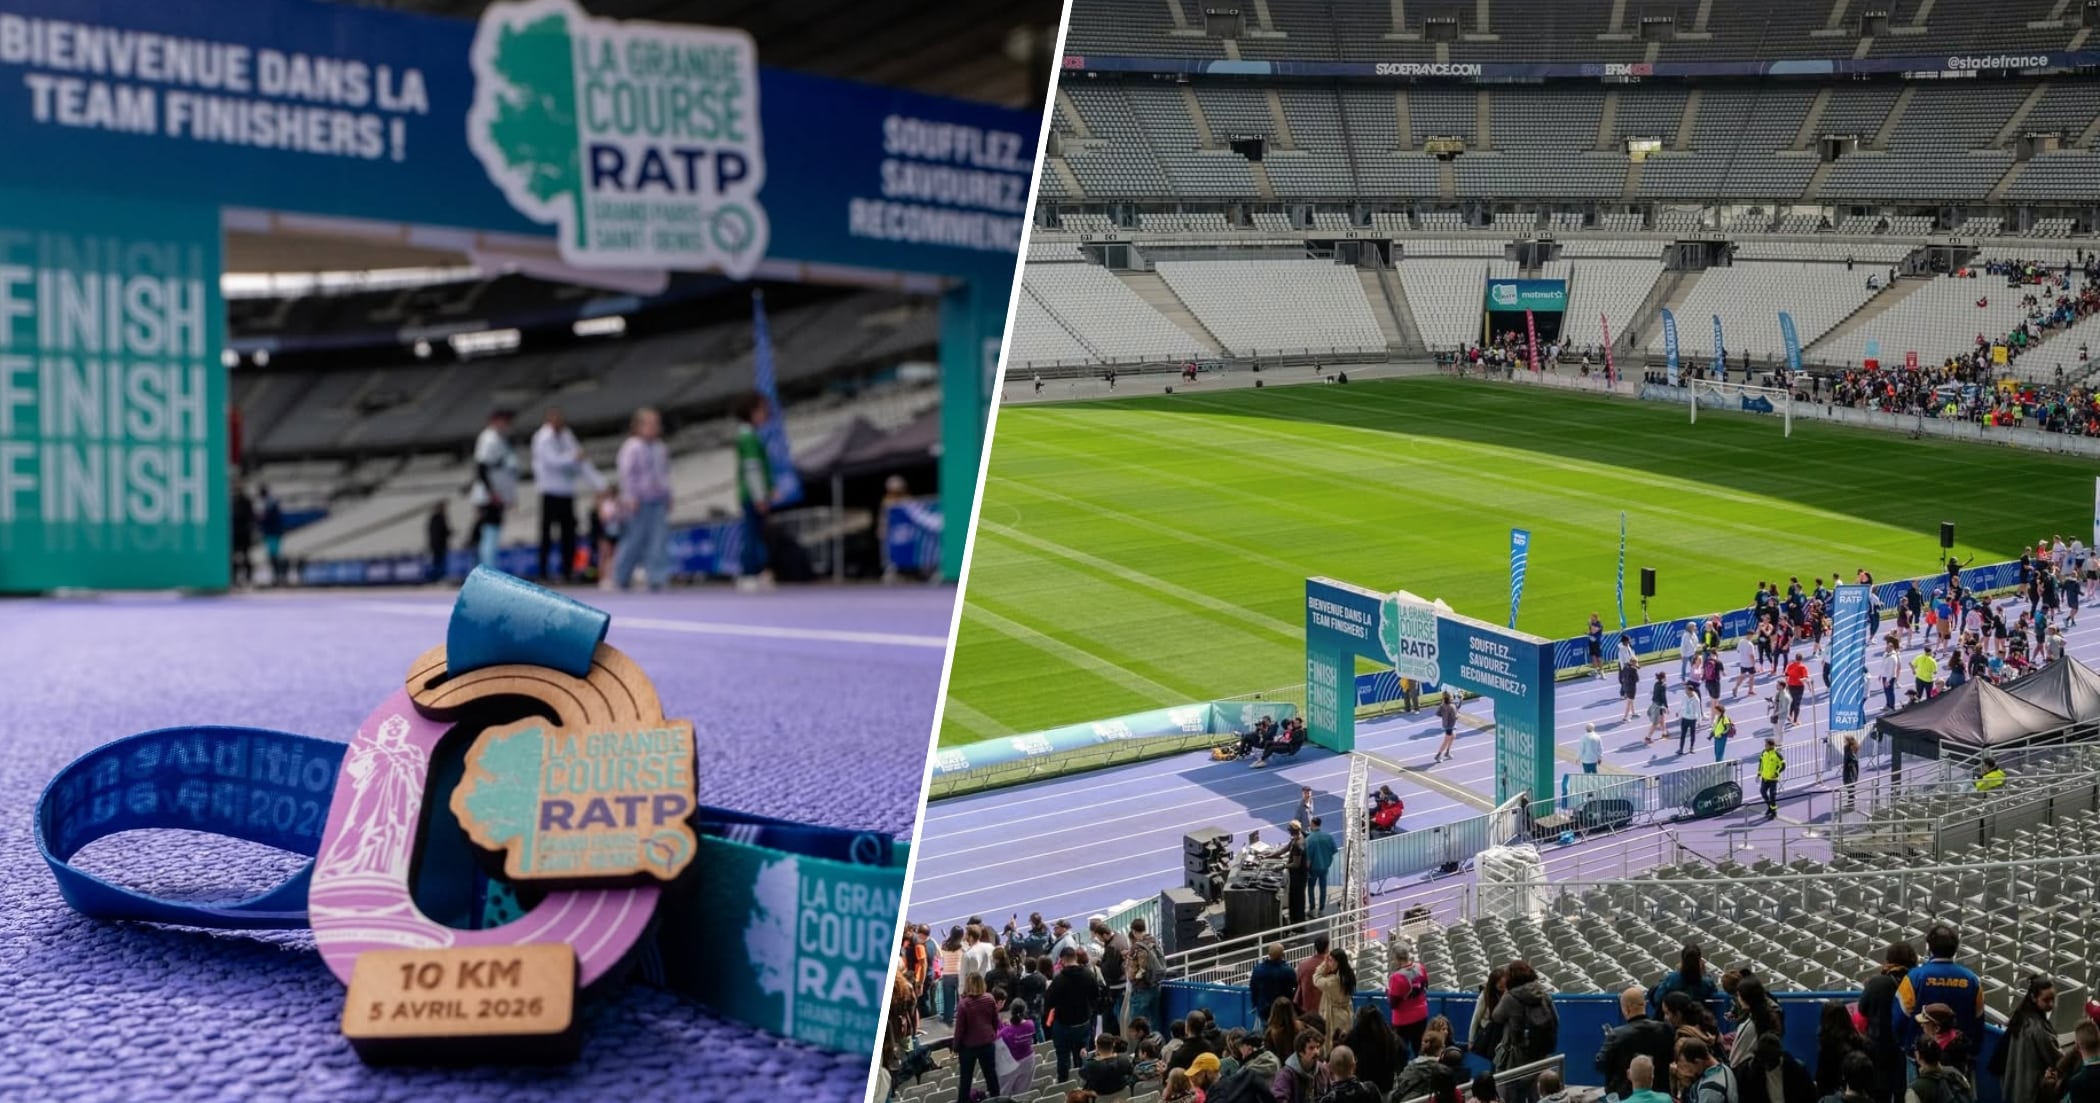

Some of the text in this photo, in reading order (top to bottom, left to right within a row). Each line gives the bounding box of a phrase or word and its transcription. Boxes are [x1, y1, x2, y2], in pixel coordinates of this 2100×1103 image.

[1, 13, 430, 115] BIENVENUE DANS LA
[580, 38, 743, 80] LA GRANDE
[1375, 63, 1481, 76] STADEFRANCE.COM
[1947, 54, 2048, 70] @stadefrance
[24, 77, 405, 162] TEAM FINISHERS !
[585, 82, 747, 142] COURSE
[589, 145, 749, 195] RATP
[0, 264, 206, 357] FINISH
[1521, 291, 1554, 299] matmut
[0, 354, 207, 442] FINISH
[0, 440, 208, 525] FINISH
[1308, 596, 1372, 627] BIENVENUE DANS LA
[1400, 605, 1434, 623] LA GRANDE
[1839, 596, 1863, 604] RATP
[1312, 611, 1331, 628] TEAM
[1331, 617, 1364, 639] FINISHERS
[1400, 619, 1435, 642] COURSE
[1401, 639, 1436, 660] RATP
[1469, 636, 1517, 662] SOUFFLEZ...
[1308, 658, 1337, 689] FINISH
[1460, 665, 1520, 695] RECOMMENCEZ
[1469, 651, 1518, 679] SAVOUREZ...
[1308, 682, 1337, 712] FINISH
[1308, 704, 1337, 734] FINISH
[1835, 716, 1859, 724] RATP
[549, 727, 687, 760] LA GRANDE
[1498, 723, 1535, 759] FINISH
[544, 752, 688, 796] COURSE
[1498, 749, 1535, 785] FINISH
[247, 788, 330, 838] 202
[539, 793, 689, 831] RATP
[801, 875, 828, 909] LA
[799, 909, 891, 964] COUR
[400, 958, 522, 991] 10 KM
[1925, 976, 1969, 989] RAMS
[368, 997, 544, 1022] 5 AVRIL 2026
